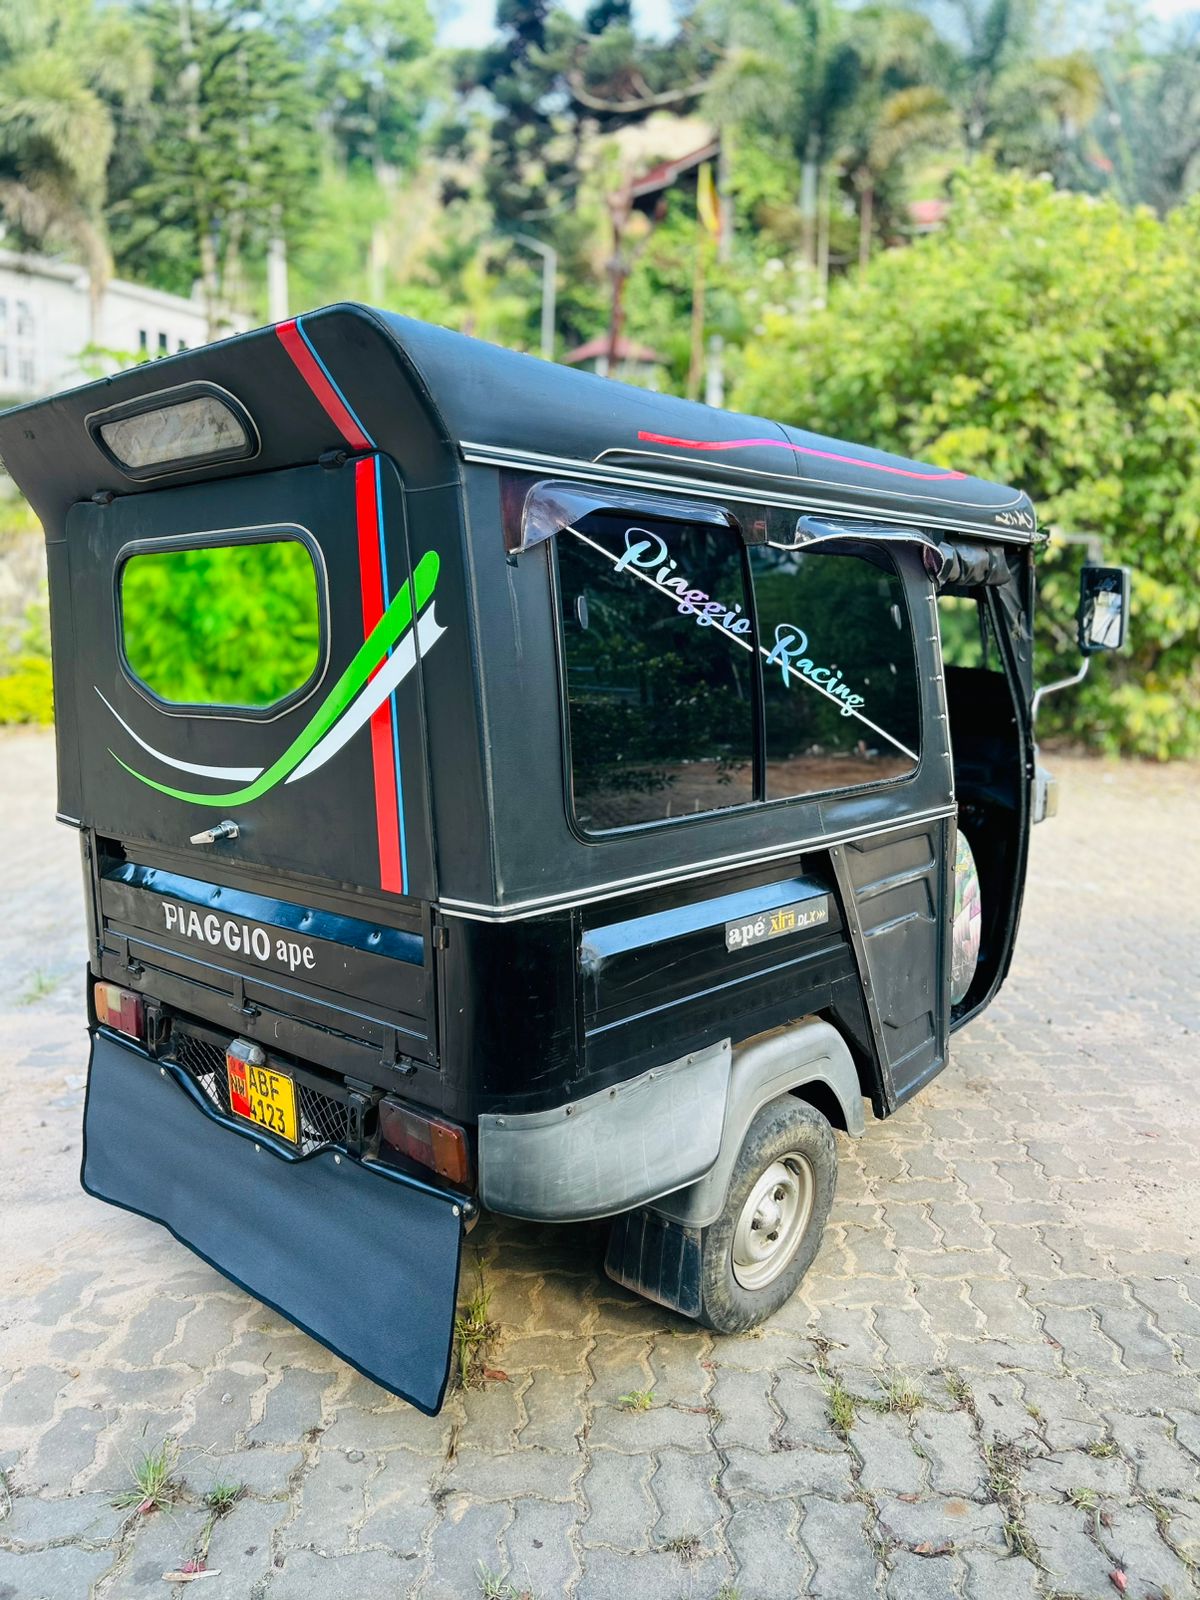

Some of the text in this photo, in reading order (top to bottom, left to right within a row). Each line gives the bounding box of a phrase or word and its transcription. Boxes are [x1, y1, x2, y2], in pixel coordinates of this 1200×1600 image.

[614, 527, 865, 716] Piaggio Racing
[162, 901, 317, 972] PIAGGIO ape
[797, 910, 816, 926] DLX
[249, 1065, 281, 1101] ABF
[249, 1095, 286, 1134] 4123
